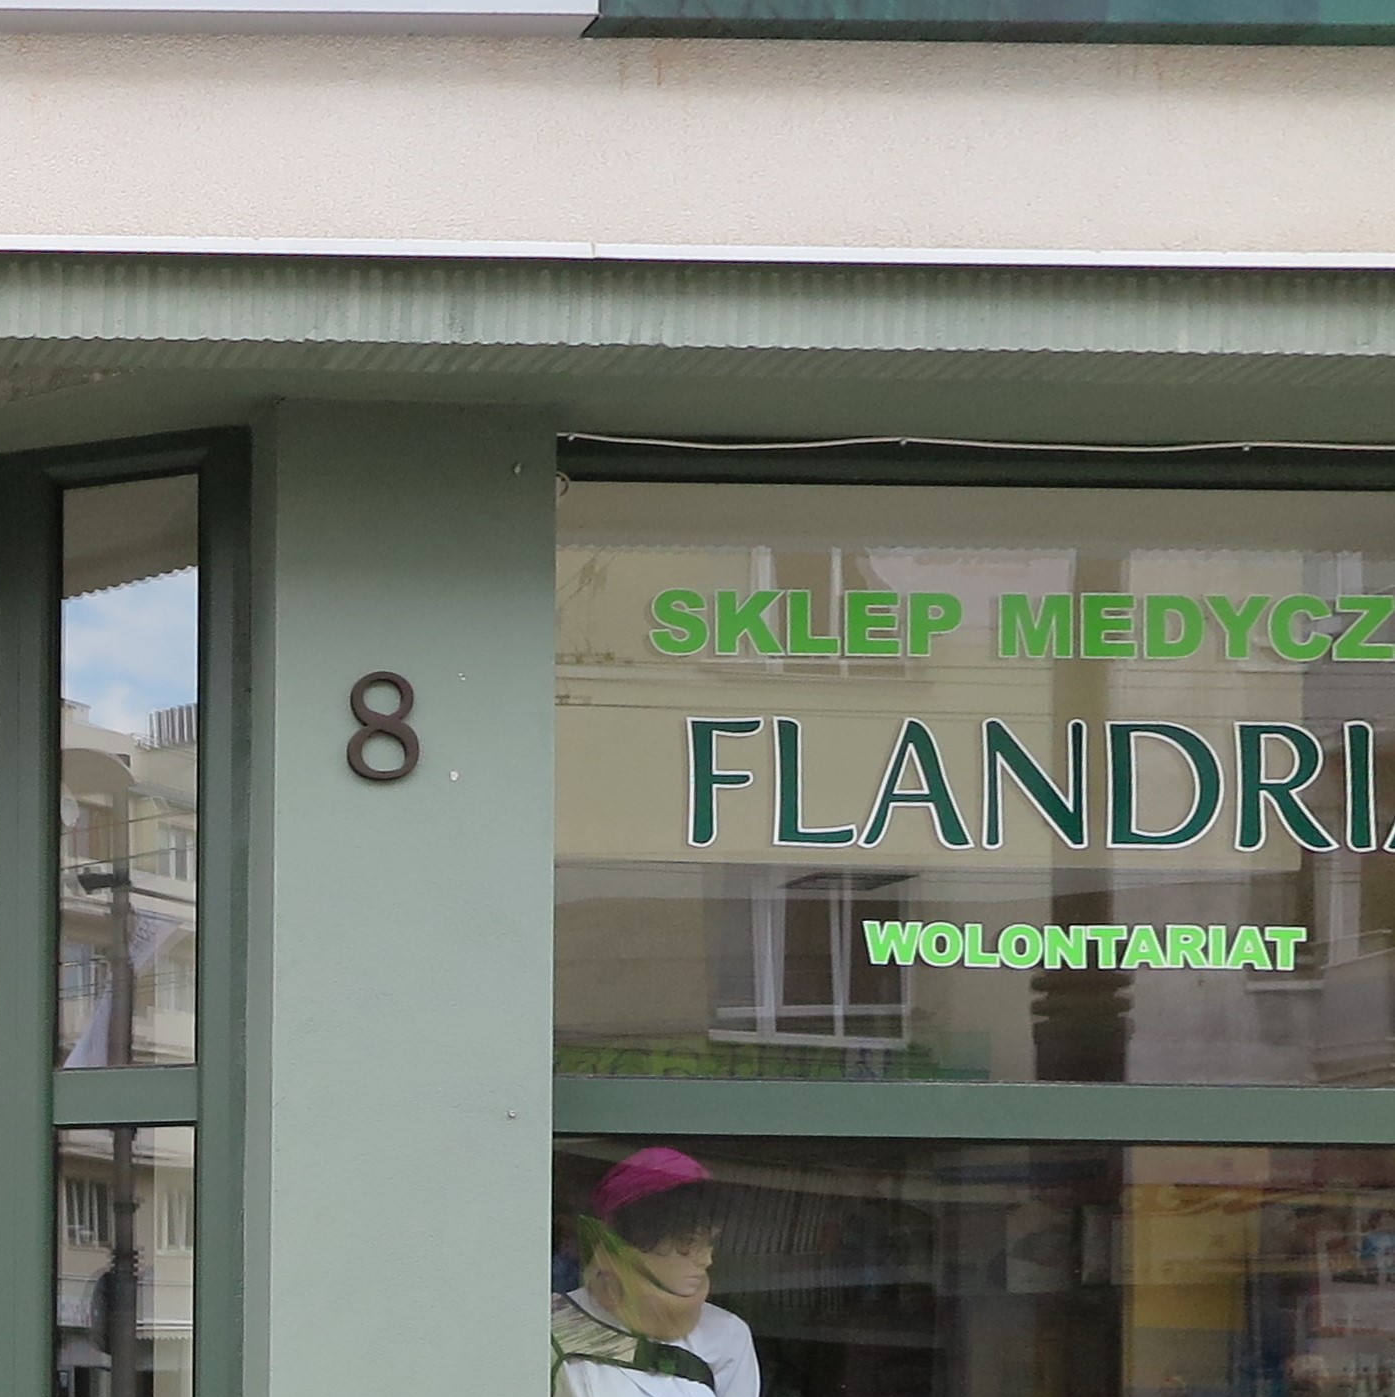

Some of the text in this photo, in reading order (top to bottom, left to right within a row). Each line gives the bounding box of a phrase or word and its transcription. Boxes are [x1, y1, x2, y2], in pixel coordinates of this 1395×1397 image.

[649, 588, 1395, 662] SKLEP MEDYCZ
[347, 671, 420, 781] 8
[686, 716, 1395, 853] FLANDRI
[862, 920, 1307, 970] WOLONTARIAT
